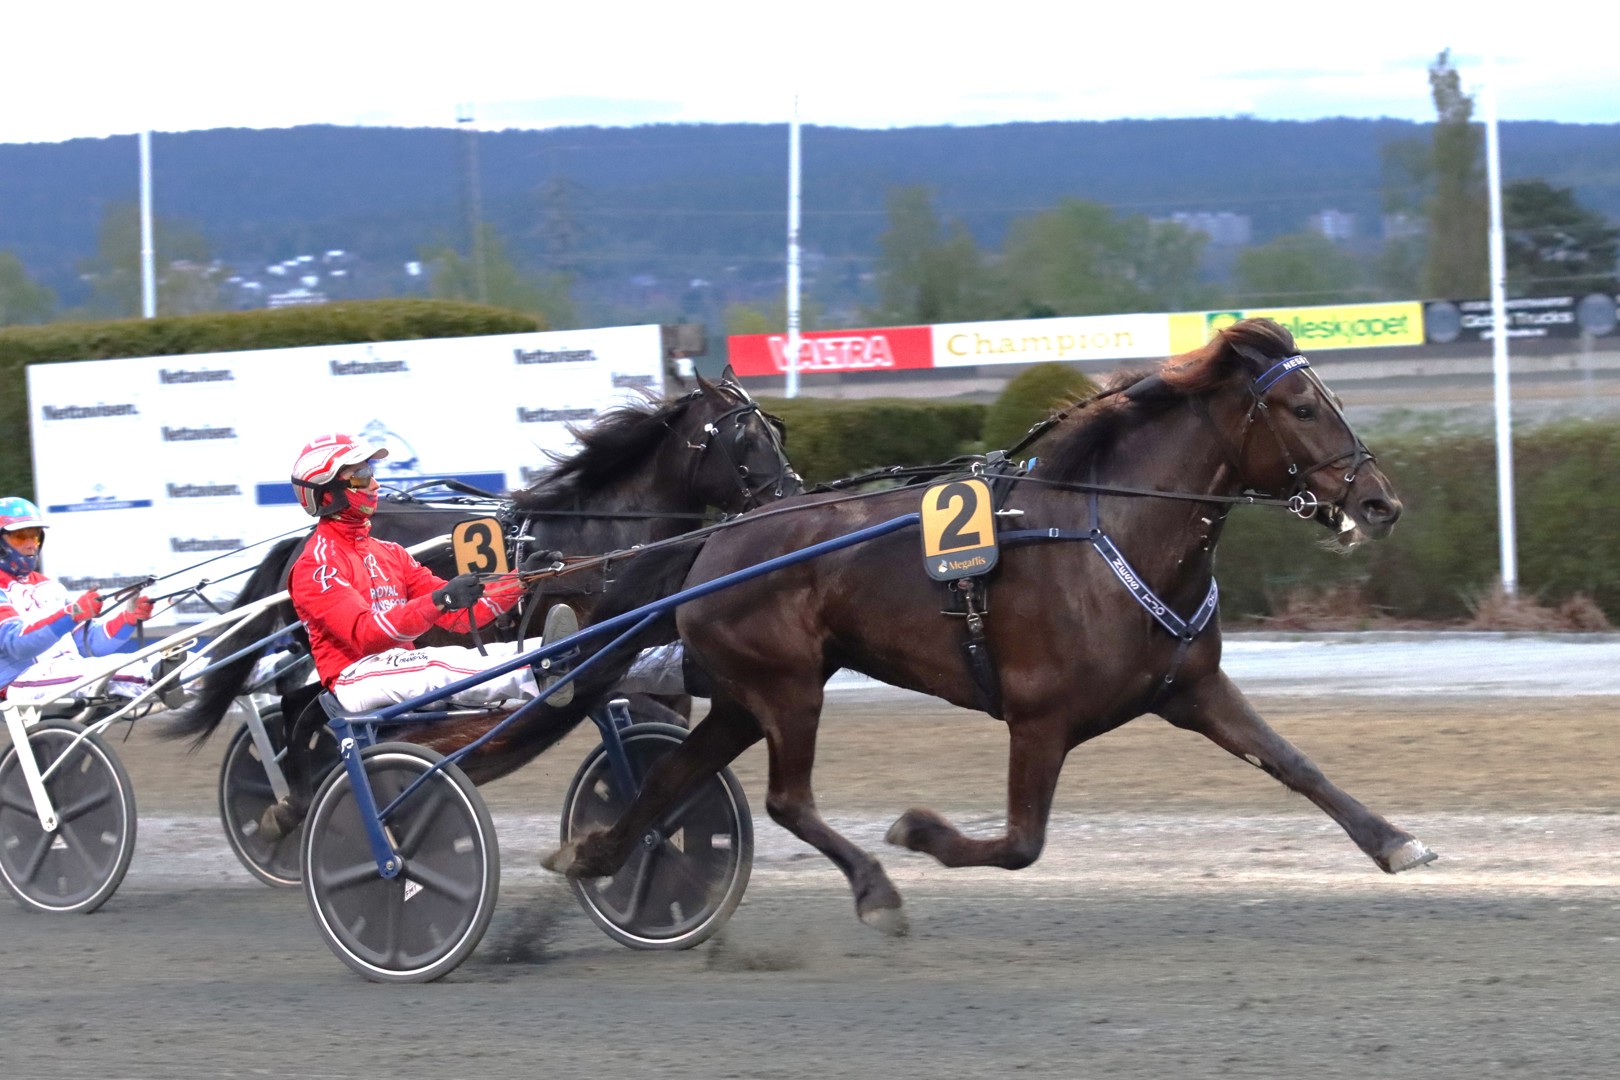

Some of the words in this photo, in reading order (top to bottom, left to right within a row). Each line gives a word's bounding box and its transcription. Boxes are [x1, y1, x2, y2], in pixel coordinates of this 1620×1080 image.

[946, 333, 1134, 355] Champion
[936, 482, 981, 552] 2
[463, 522, 498, 576] 3
[948, 555, 987, 571] Megaflis
[1112, 558, 1140, 591] NESS
[370, 584, 399, 600] ROYAL
